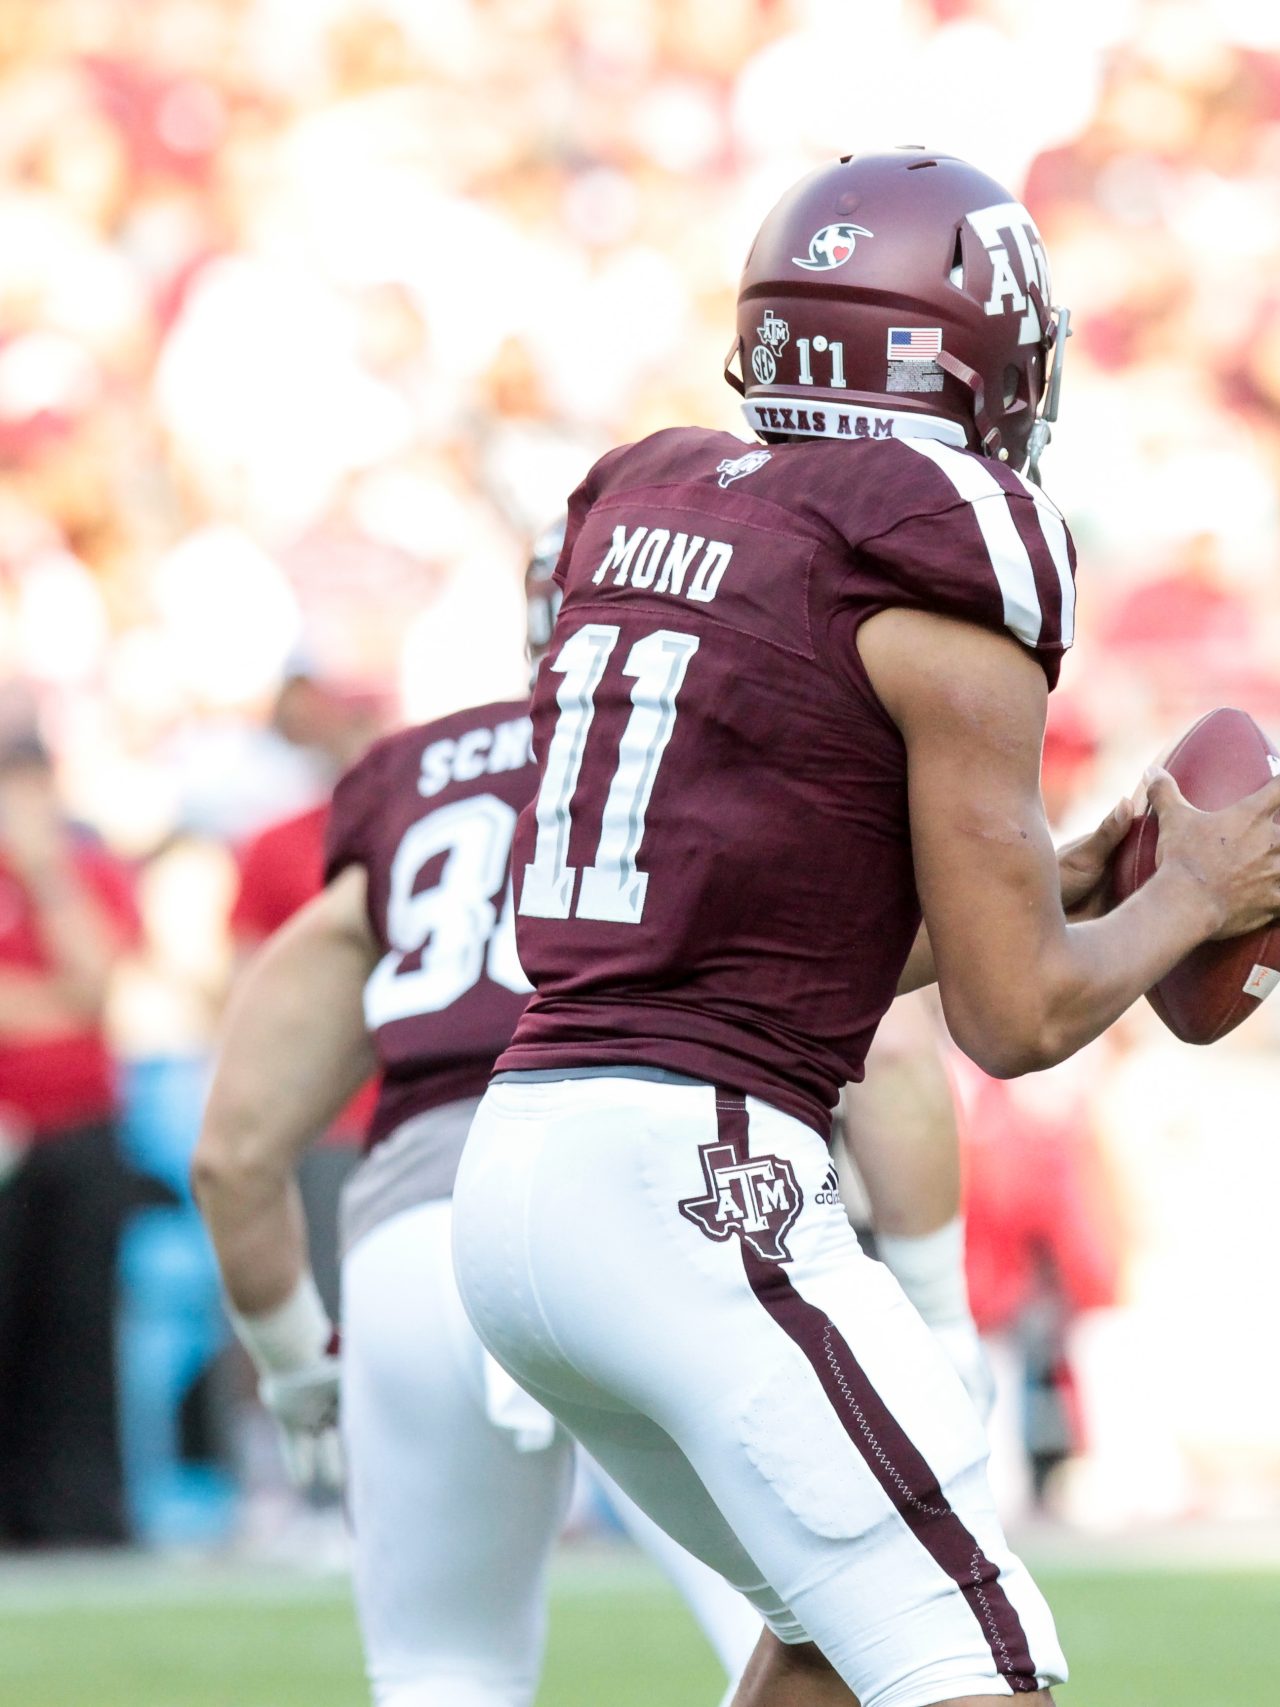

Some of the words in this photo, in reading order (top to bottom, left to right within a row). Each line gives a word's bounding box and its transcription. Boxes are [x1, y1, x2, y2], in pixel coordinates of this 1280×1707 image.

[796, 338, 846, 388] 11
[755, 406, 826, 432] TEXAS
[837, 414, 895, 438] A&M
[592, 525, 735, 603] MOND
[518, 623, 701, 925] 11
